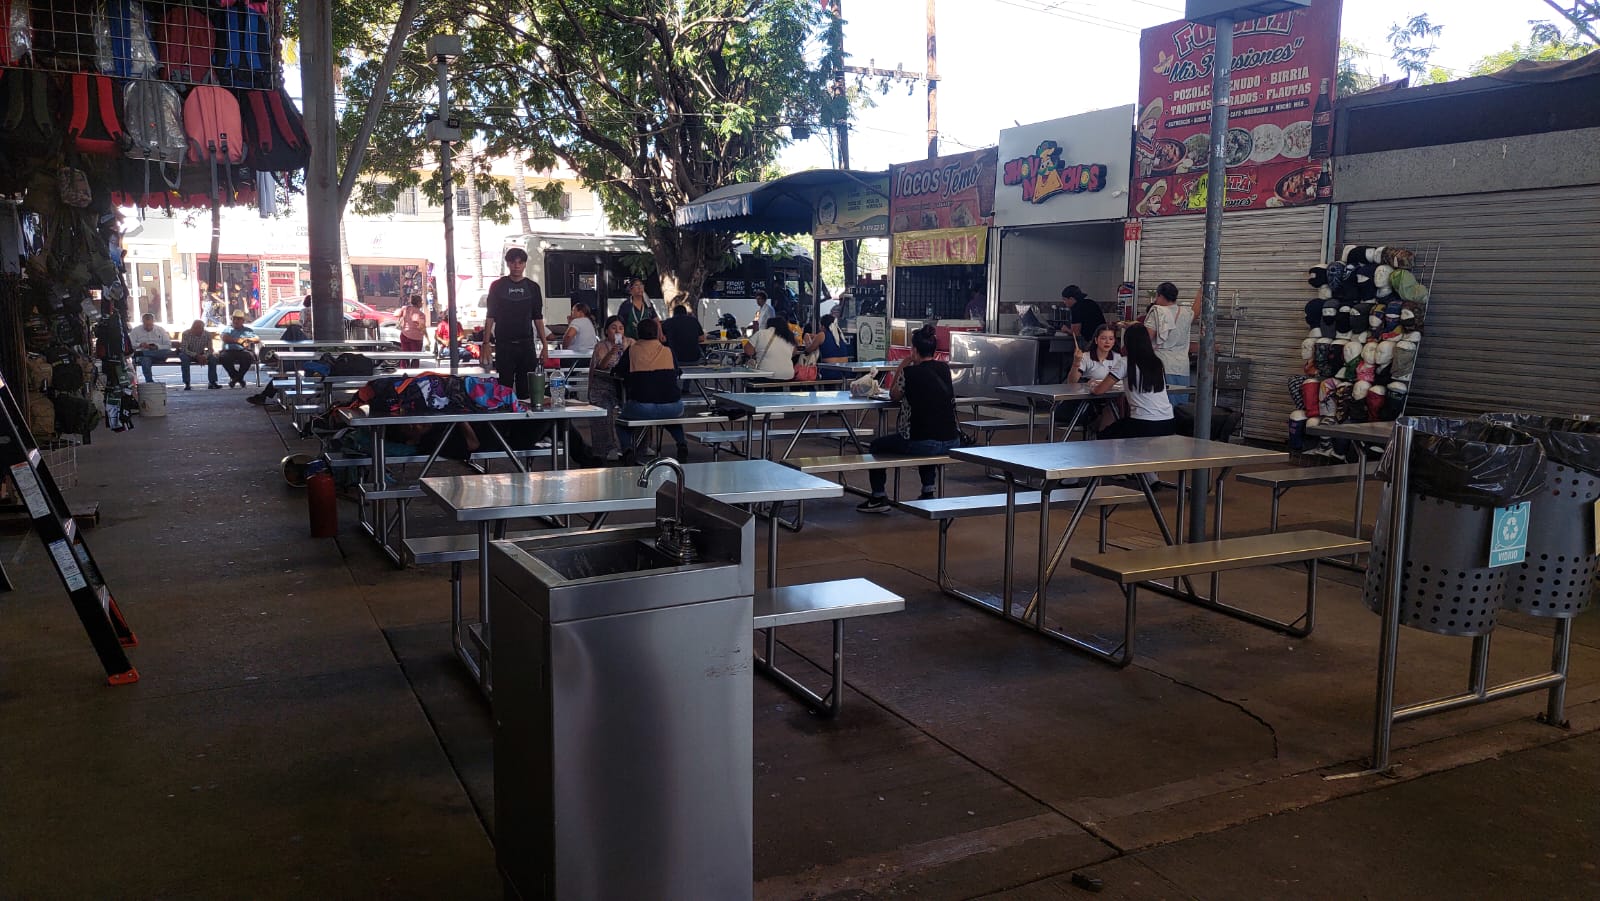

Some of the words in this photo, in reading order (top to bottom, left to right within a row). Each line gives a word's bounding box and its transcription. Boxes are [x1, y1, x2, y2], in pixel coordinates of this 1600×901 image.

[1170, 100, 1212, 115] TAQUITOS
[1228, 91, 1259, 106] RADOS
[1266, 83, 1312, 100] FLAUTAS
[1173, 85, 1210, 101] POZOLE
[1229, 75, 1261, 91] ENUDO
[1270, 66, 1310, 85] BIRRIA
[895, 166, 941, 197] Tacos
[942, 161, 983, 199] Temo
[1498, 549, 1518, 562] VIDRIO
